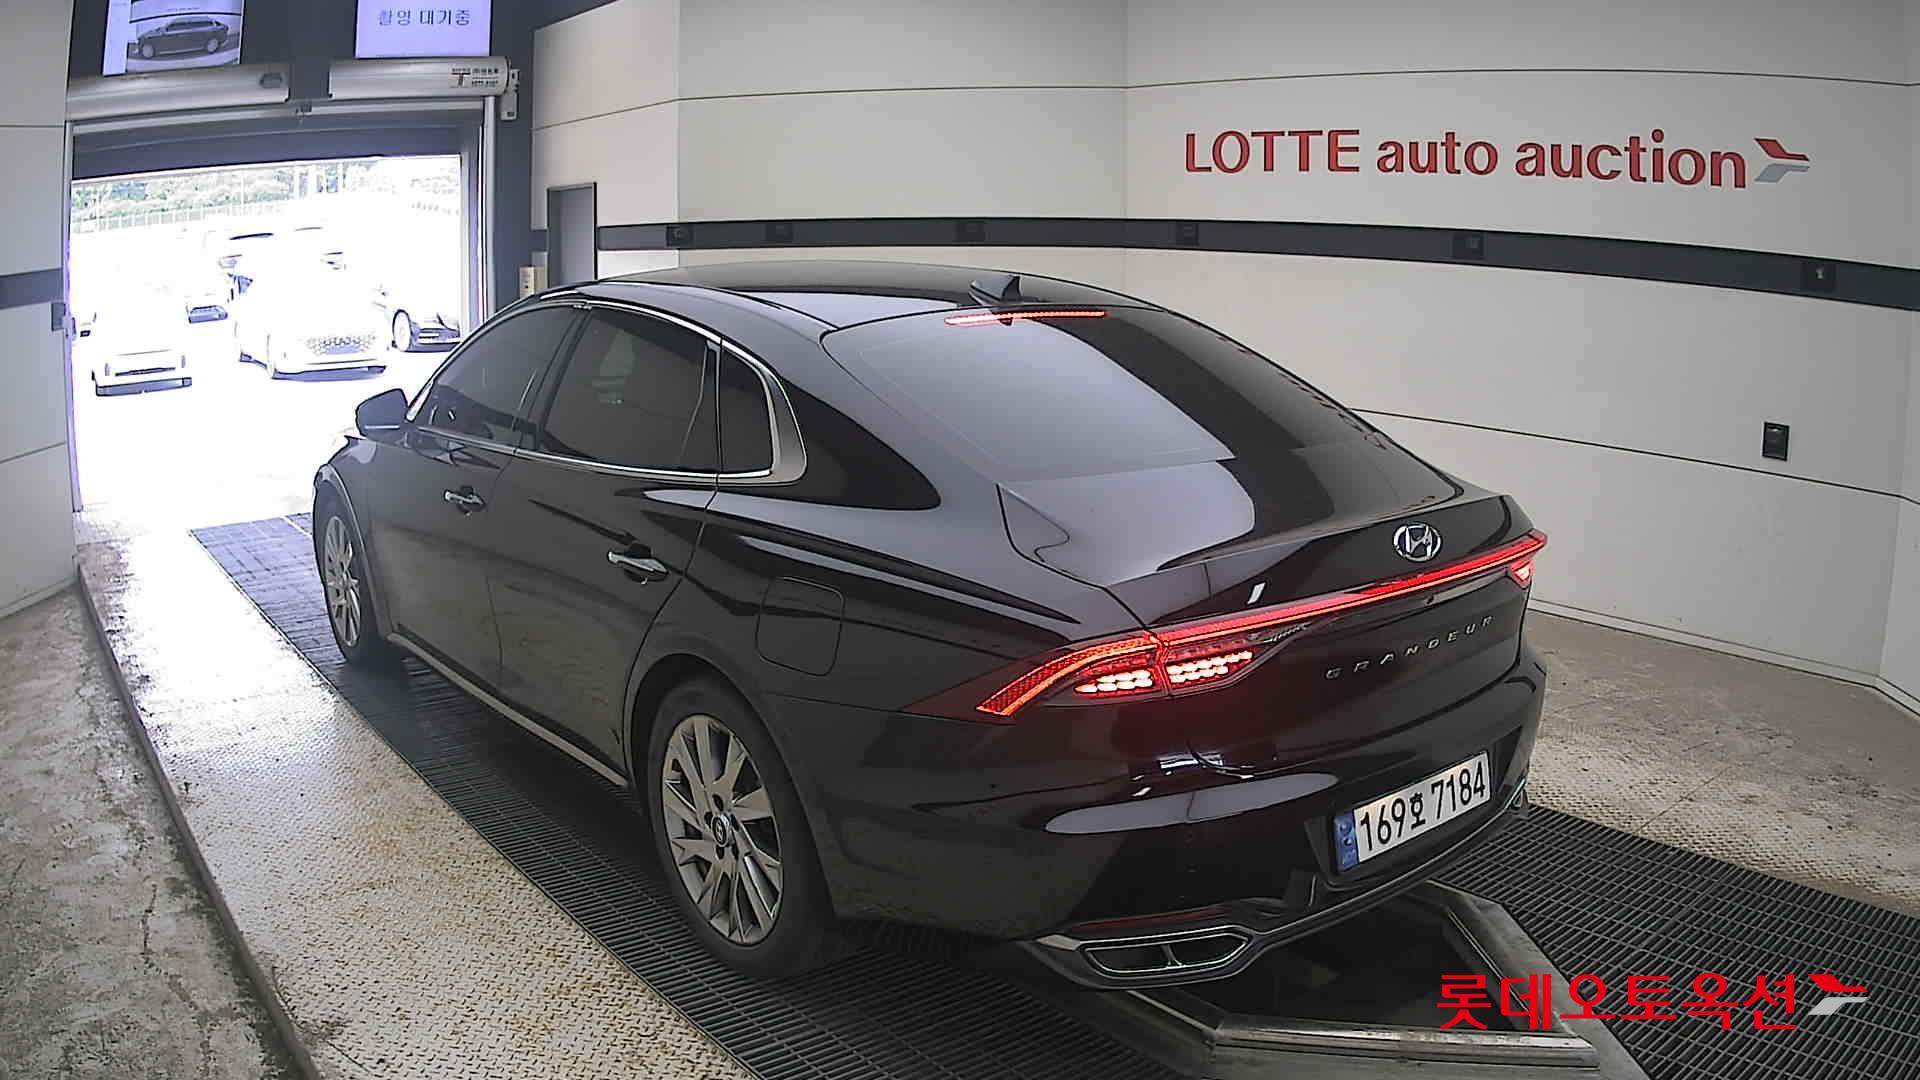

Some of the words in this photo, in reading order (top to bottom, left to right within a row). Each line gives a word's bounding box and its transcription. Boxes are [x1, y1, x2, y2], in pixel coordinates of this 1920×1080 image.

[419, 9, 471, 26] 대기중
[1185, 129, 1361, 174] LOTTE
[1376, 131, 1498, 176] auto
[1514, 128, 1747, 189] auction
[1325, 615, 1495, 680] GRANDEUR
[1360, 793, 1426, 851] 169호
[1431, 762, 1486, 820] 7184
